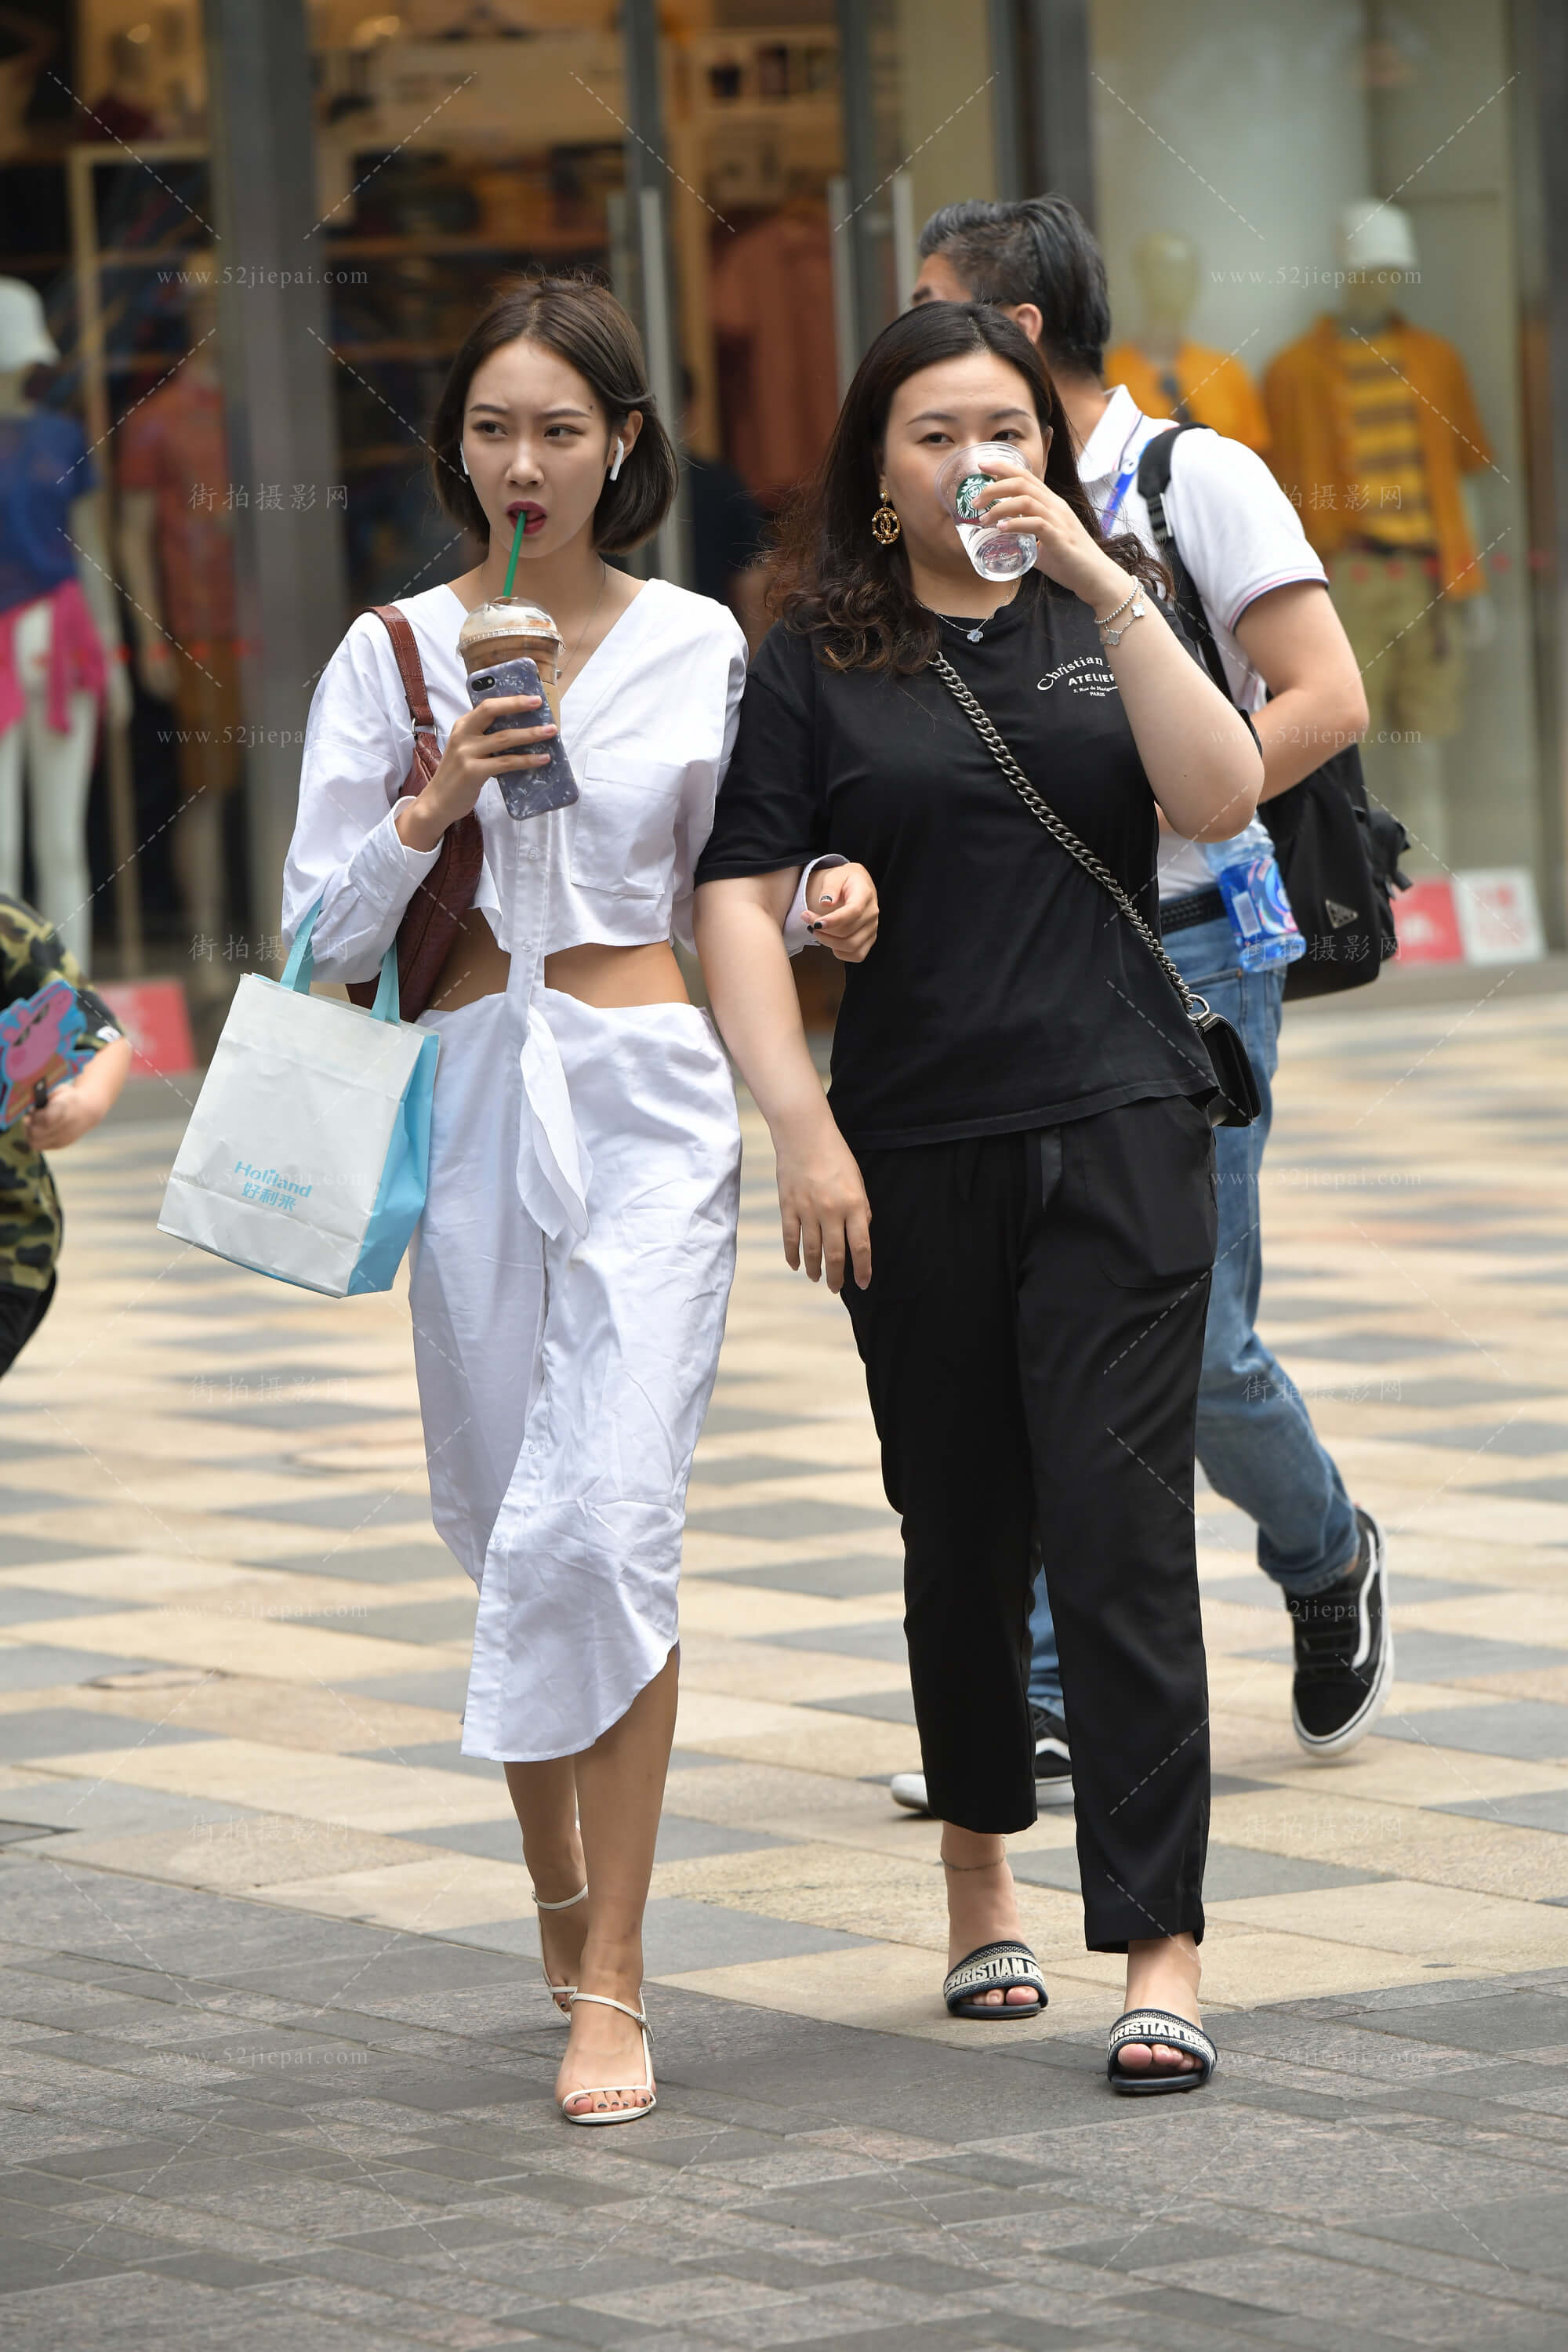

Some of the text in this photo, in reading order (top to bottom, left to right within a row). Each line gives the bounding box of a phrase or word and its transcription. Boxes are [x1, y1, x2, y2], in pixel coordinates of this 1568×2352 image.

[1037, 656, 1104, 691] Christian
[234, 1160, 312, 1198] Holiland
[241, 1181, 296, 1211] 好利来
